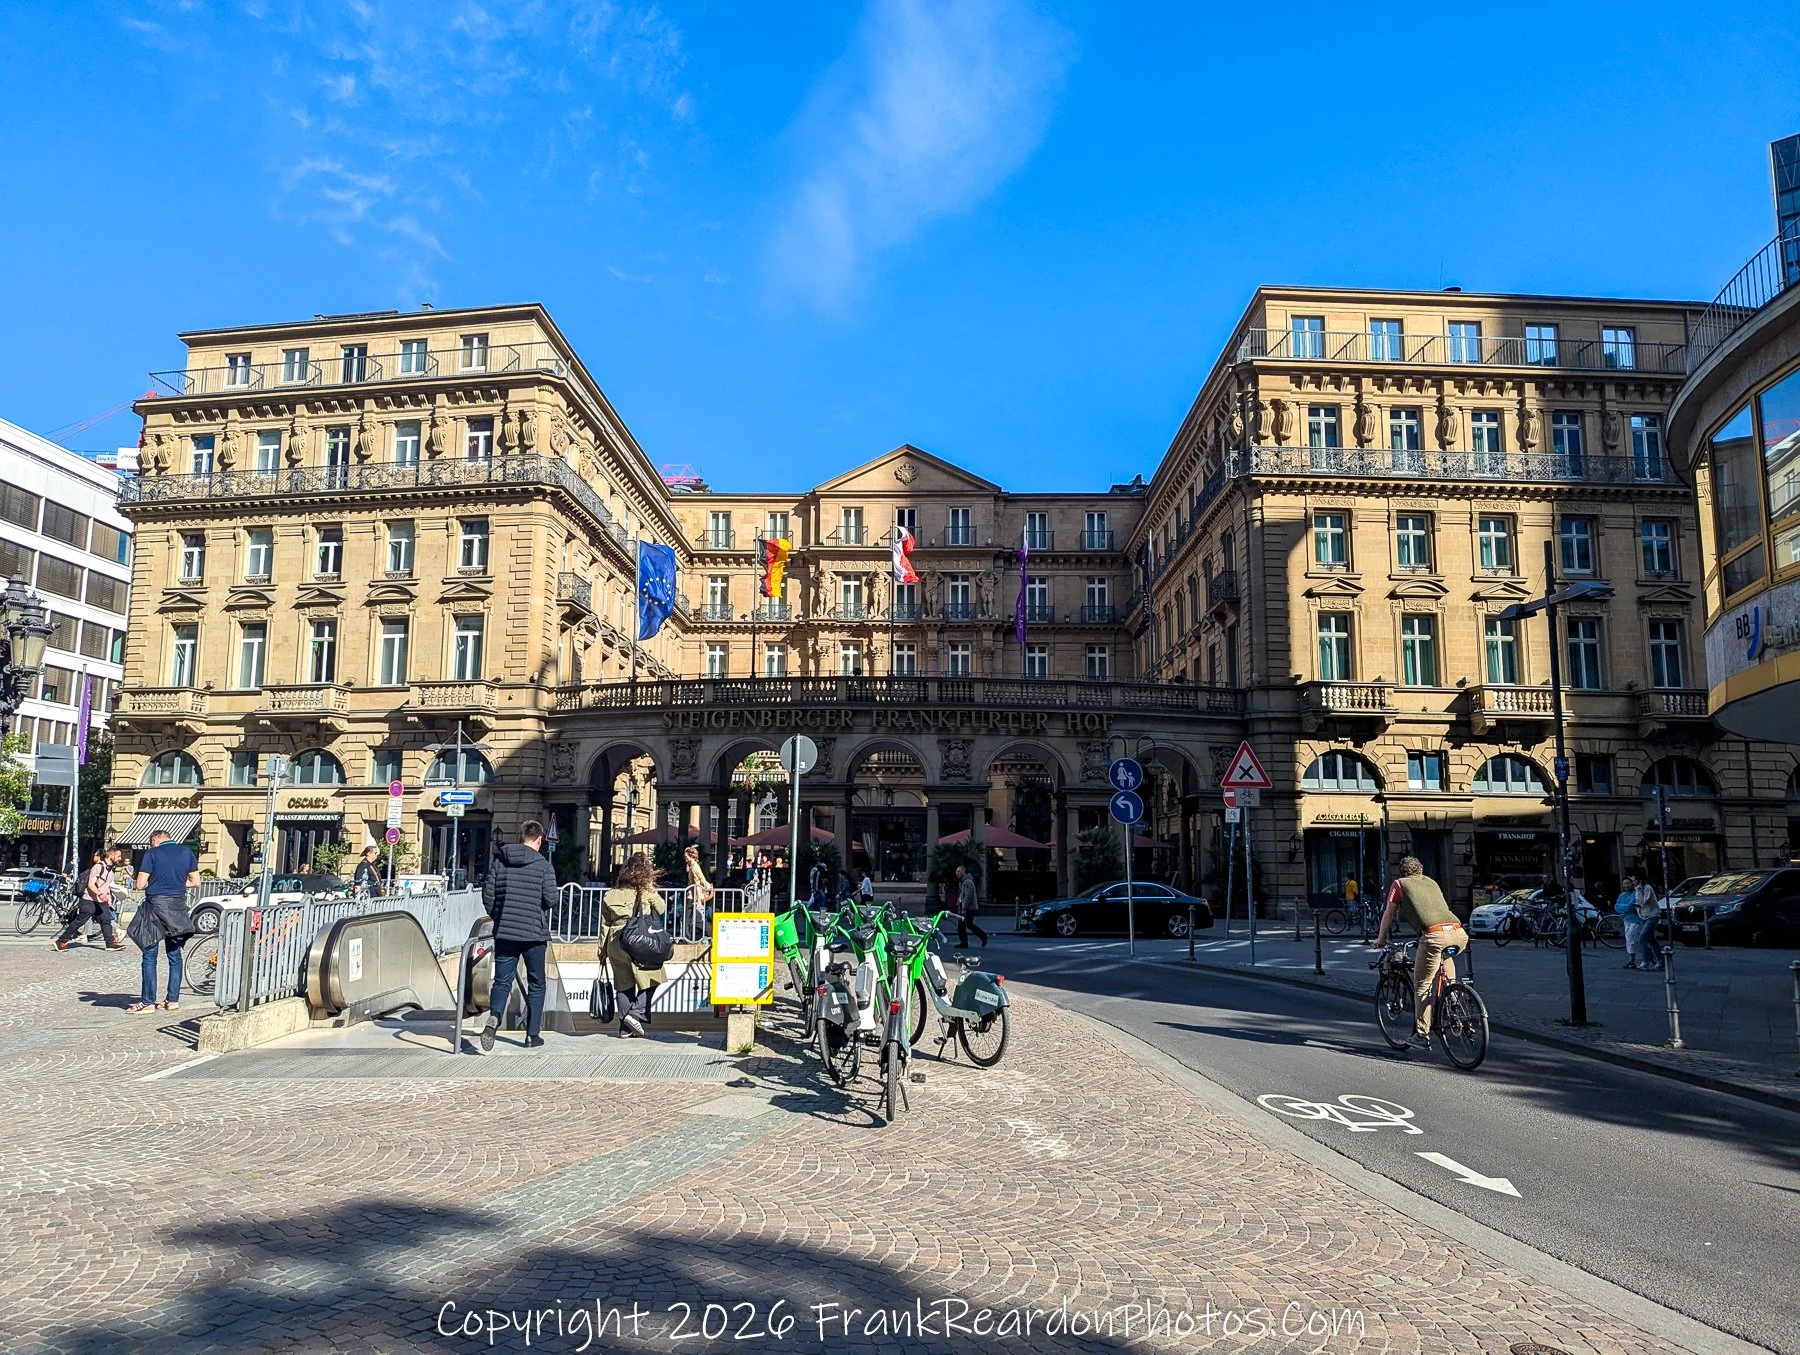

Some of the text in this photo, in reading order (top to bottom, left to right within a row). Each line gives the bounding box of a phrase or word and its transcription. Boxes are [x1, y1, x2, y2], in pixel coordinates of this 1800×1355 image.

[661, 709, 1114, 732] STEIGENBERGER FRANKFURTER HOF
